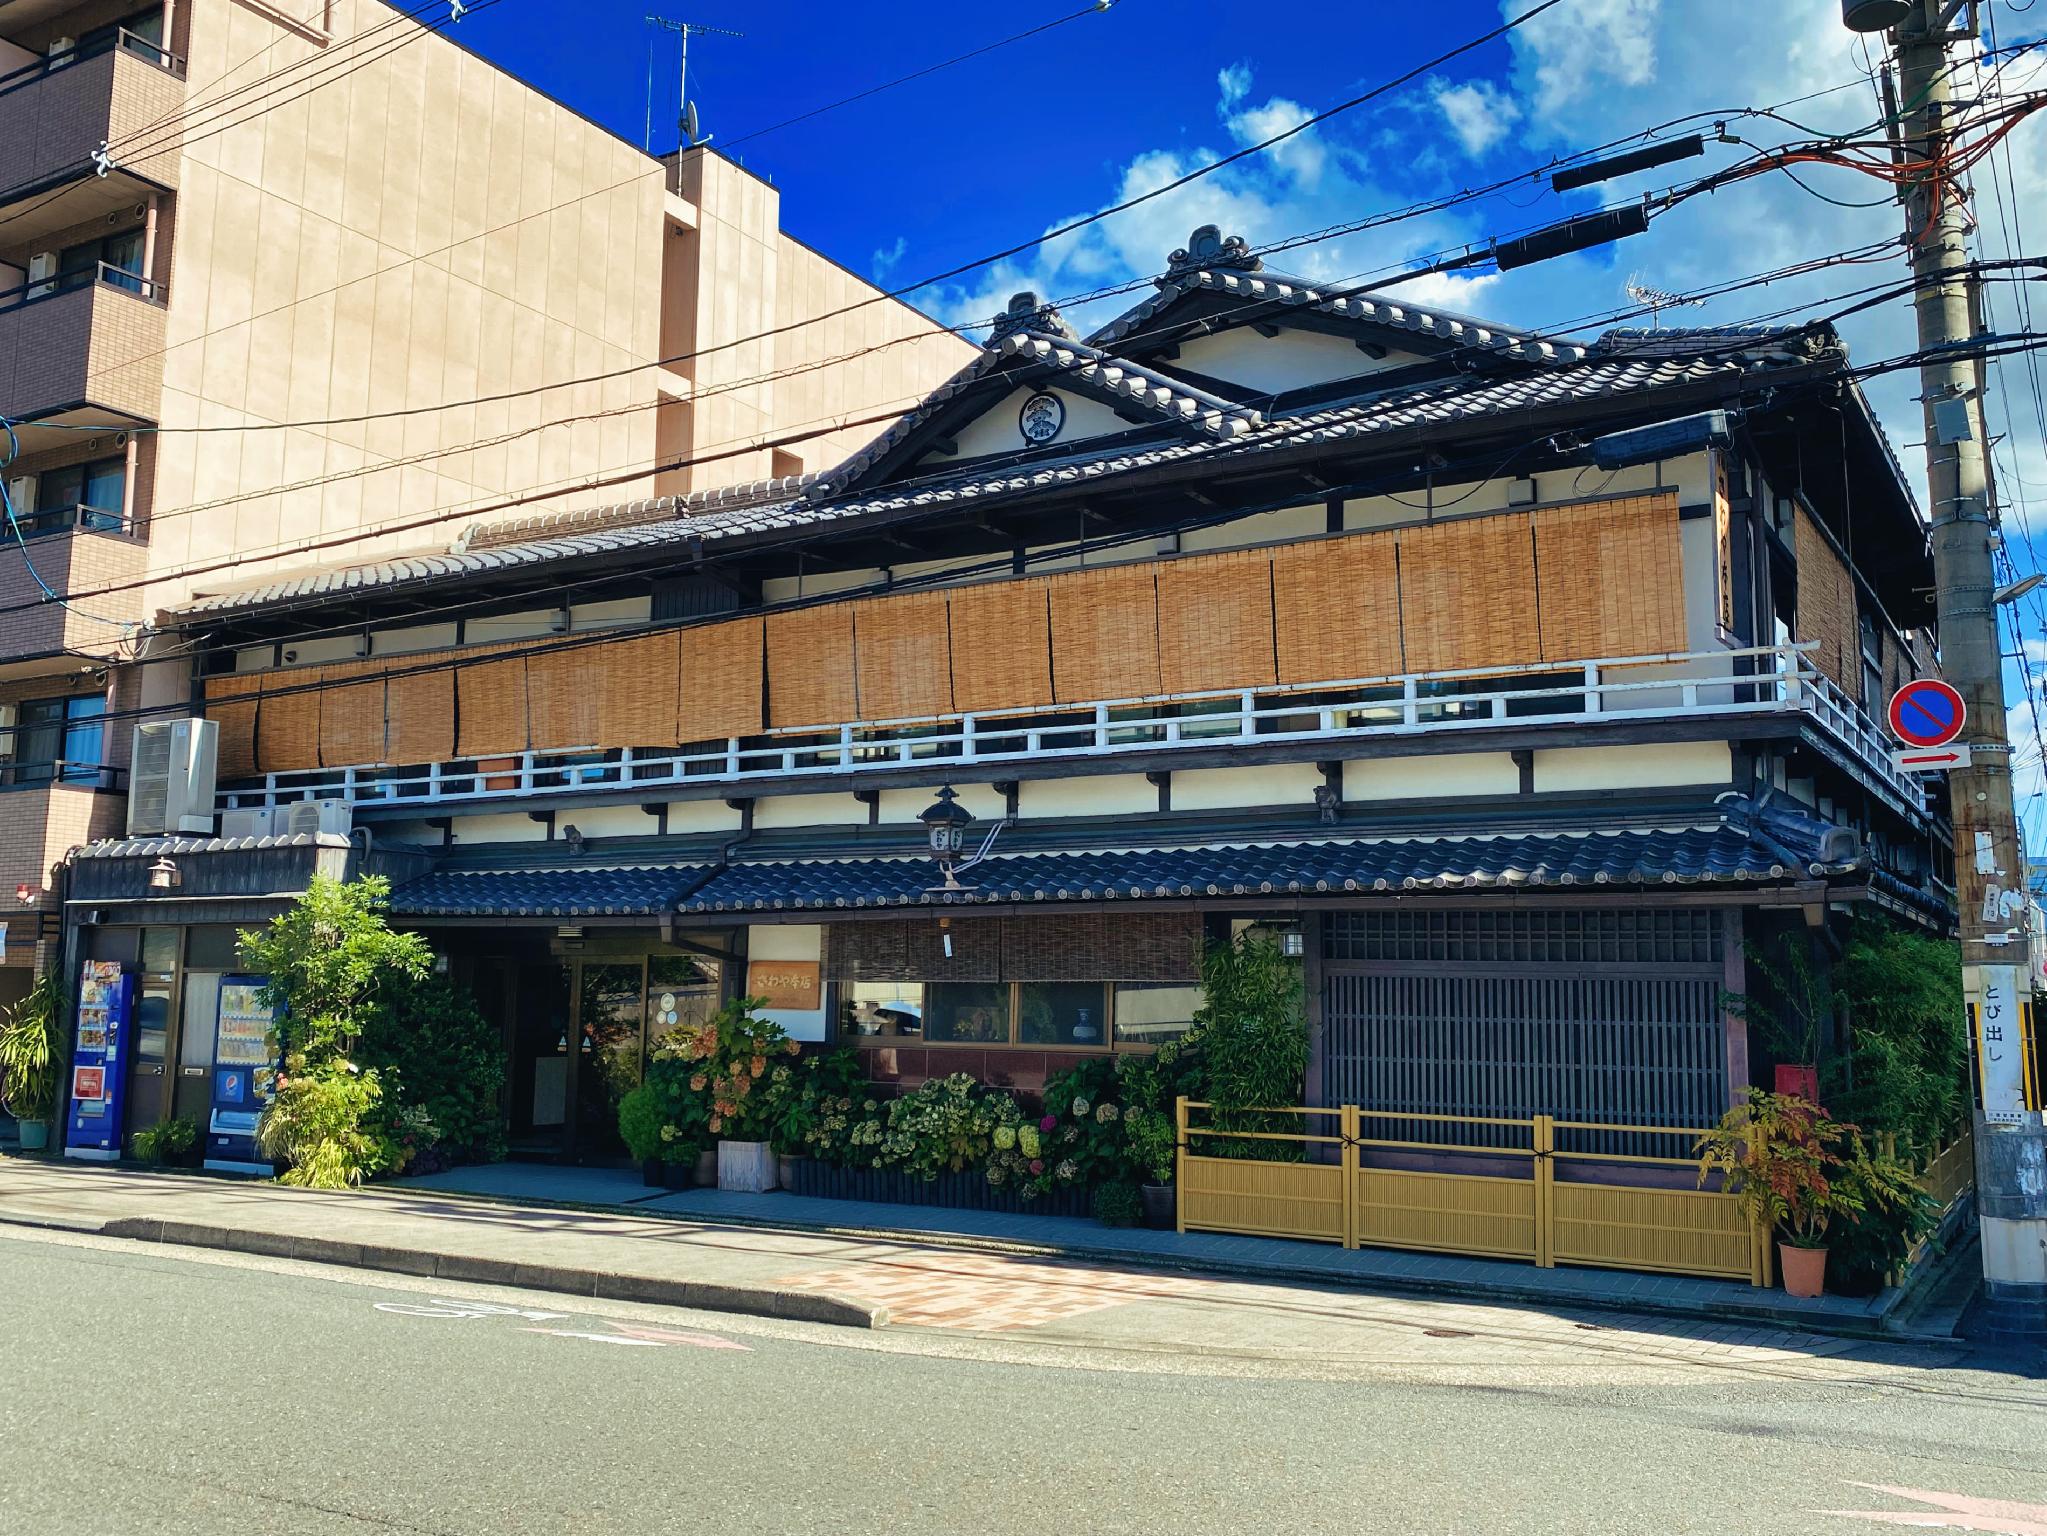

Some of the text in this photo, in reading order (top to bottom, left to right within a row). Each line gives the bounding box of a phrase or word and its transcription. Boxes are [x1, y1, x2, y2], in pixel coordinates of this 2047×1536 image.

[756, 974, 811, 990] さわや本店
[1985, 984, 2003, 1061] とび出し
